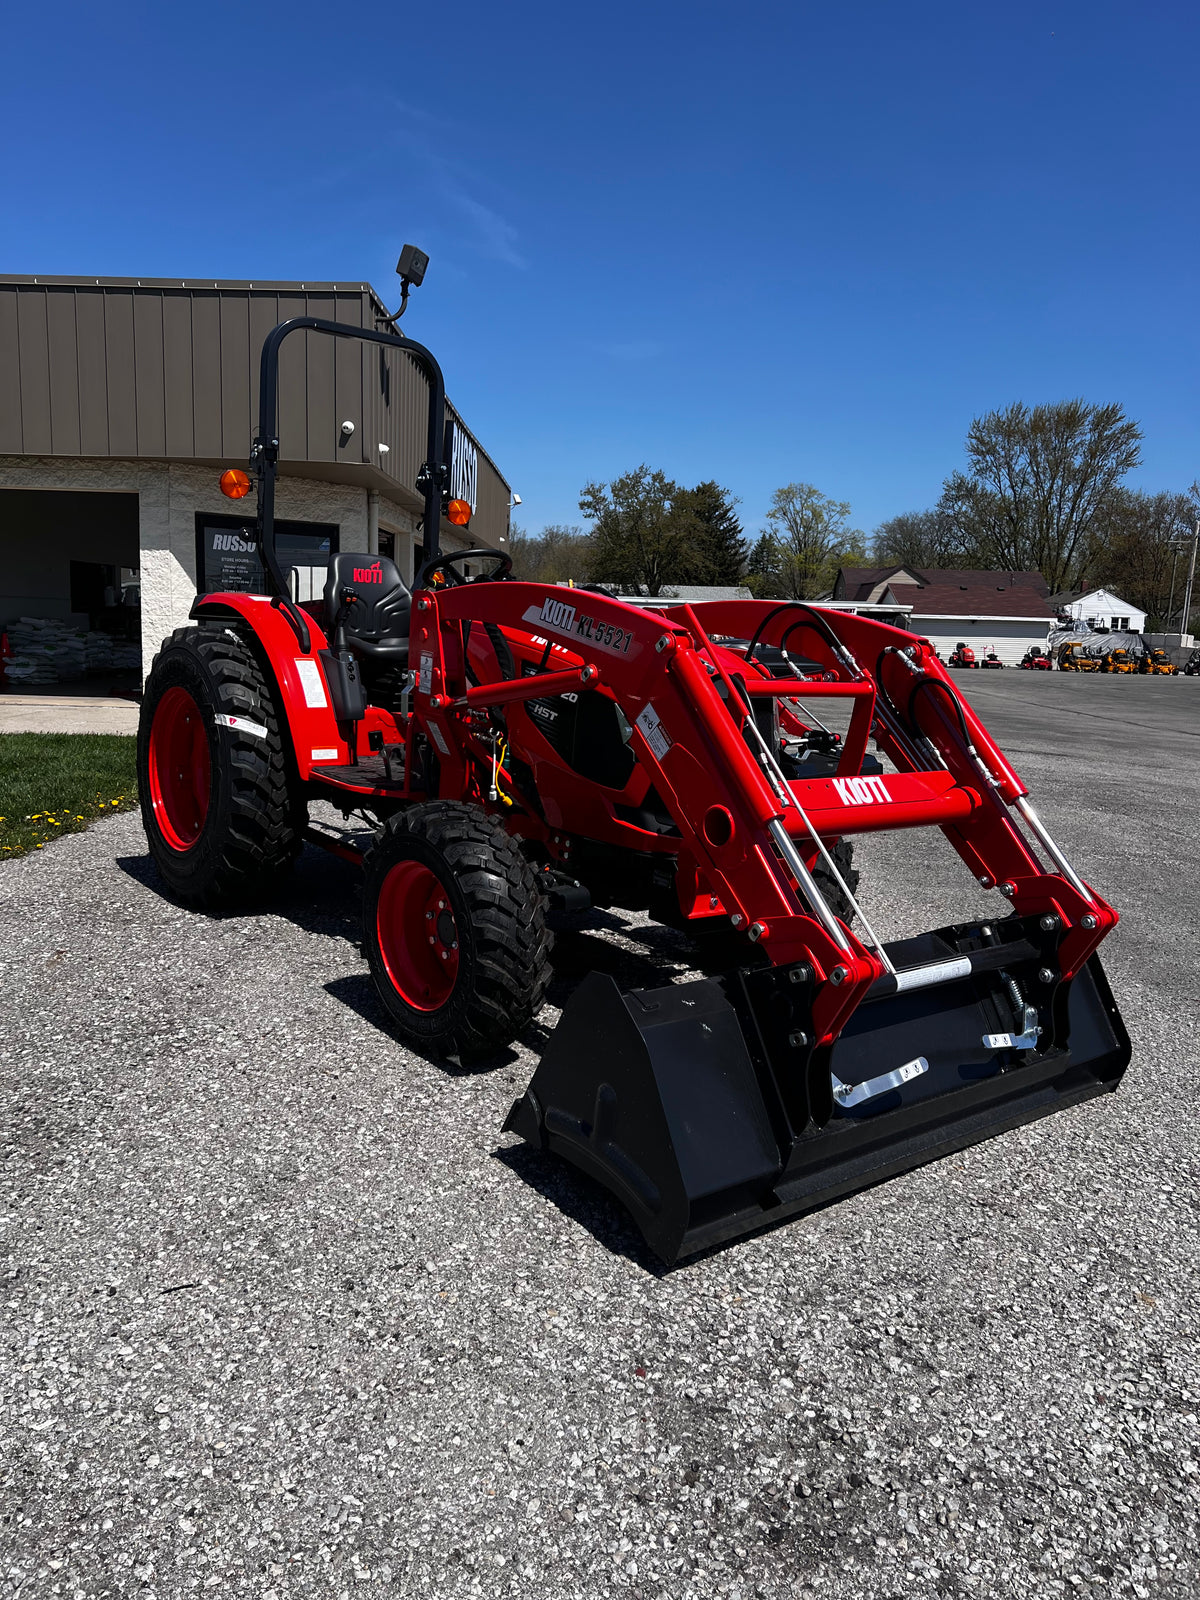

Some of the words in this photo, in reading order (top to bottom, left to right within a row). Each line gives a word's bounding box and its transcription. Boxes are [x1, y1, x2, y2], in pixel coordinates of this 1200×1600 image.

[450, 421, 478, 516] RUSSO
[212, 534, 257, 553] RUSSO
[353, 567, 383, 584] KIOTI
[539, 597, 577, 632] KIOTI
[533, 704, 558, 721] HST
[831, 776, 893, 806] KIOTI
